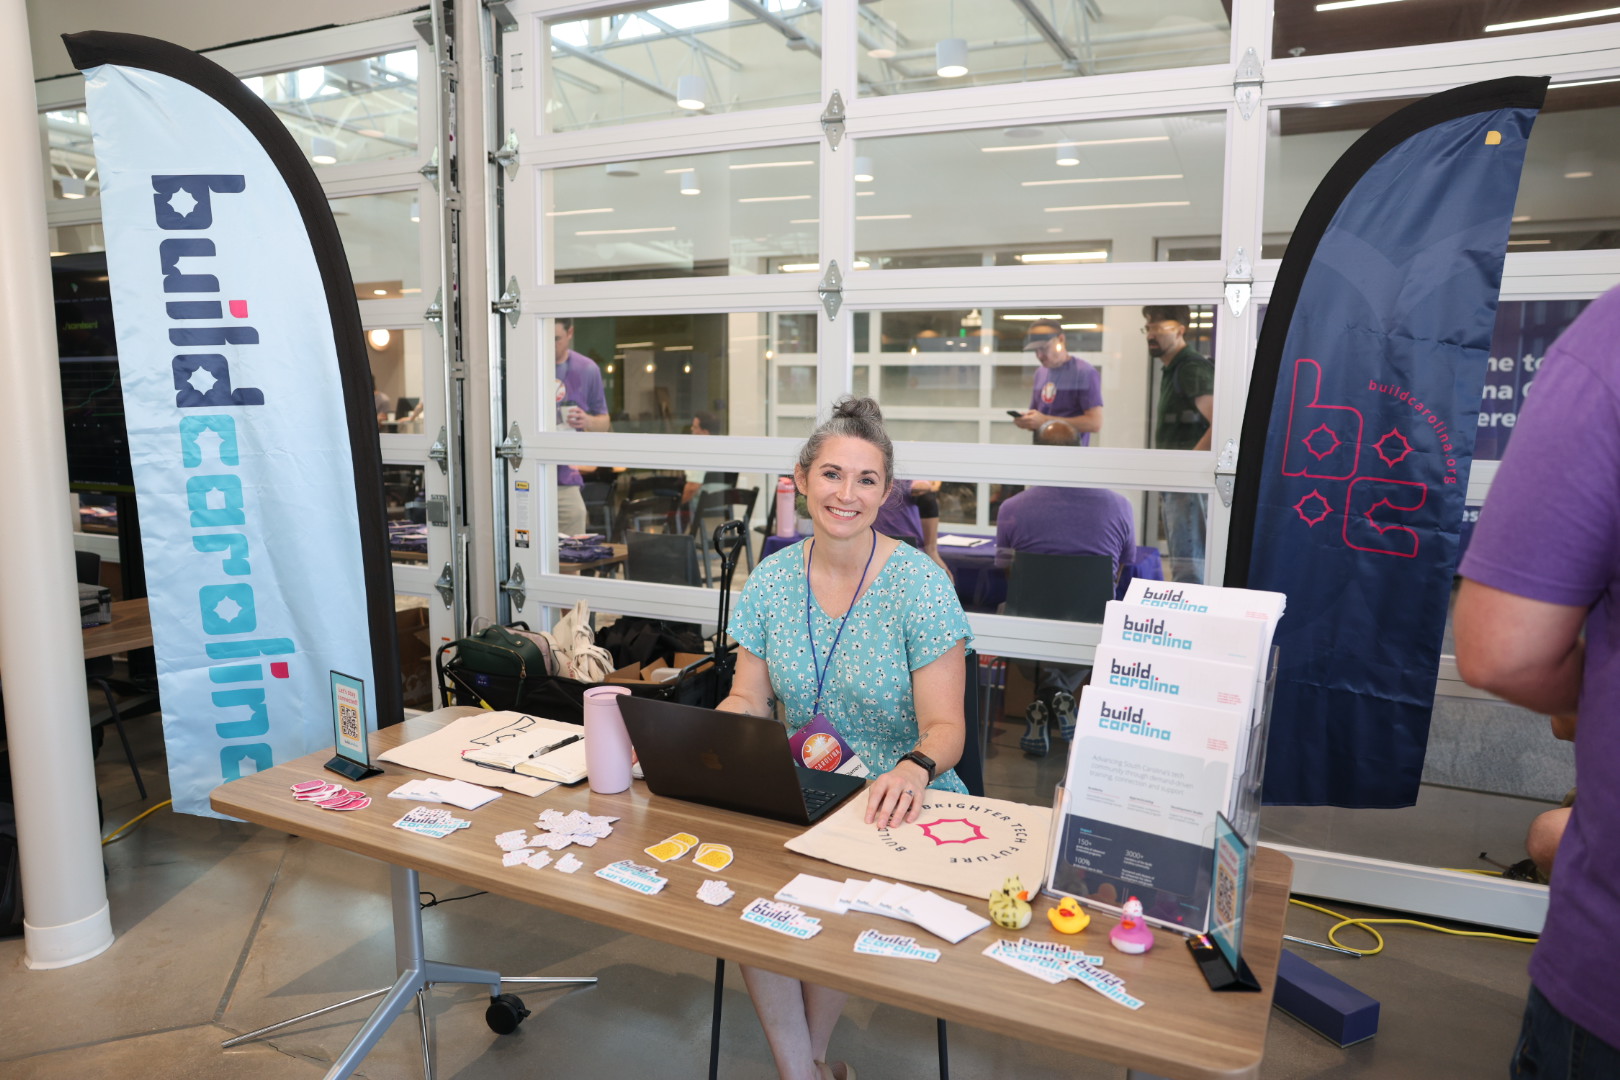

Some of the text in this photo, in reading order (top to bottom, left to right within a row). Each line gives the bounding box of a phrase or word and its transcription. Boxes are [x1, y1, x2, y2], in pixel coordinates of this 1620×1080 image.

[1368, 379, 1457, 485] buildcarolina.org
[1143, 587, 1183, 602] build
[1141, 599, 1208, 613] carolina
[1123, 614, 1164, 635] build
[1122, 631, 1192, 650] carolina
[1111, 658, 1151, 679] build
[1109, 675, 1179, 695] carolina
[1100, 701, 1143, 724] build
[1098, 718, 1171, 741] carolina
[403, 814, 438, 825] build
[922, 803, 1011, 821] BRIGHTER
[1011, 823, 1028, 844] TECH
[1077, 838, 1092, 847] 150+
[950, 846, 1020, 863] FUTURE
[1074, 856, 1091, 867] 100%
[1125, 849, 1144, 860] 3000+
[751, 904, 791, 922] build
[744, 911, 808, 937] carolina
[863, 937, 937, 960] carolina
[868, 931, 912, 947] build
[1022, 939, 1067, 953] build
[1076, 960, 1121, 986] build
[1068, 965, 1139, 1007] carolina
